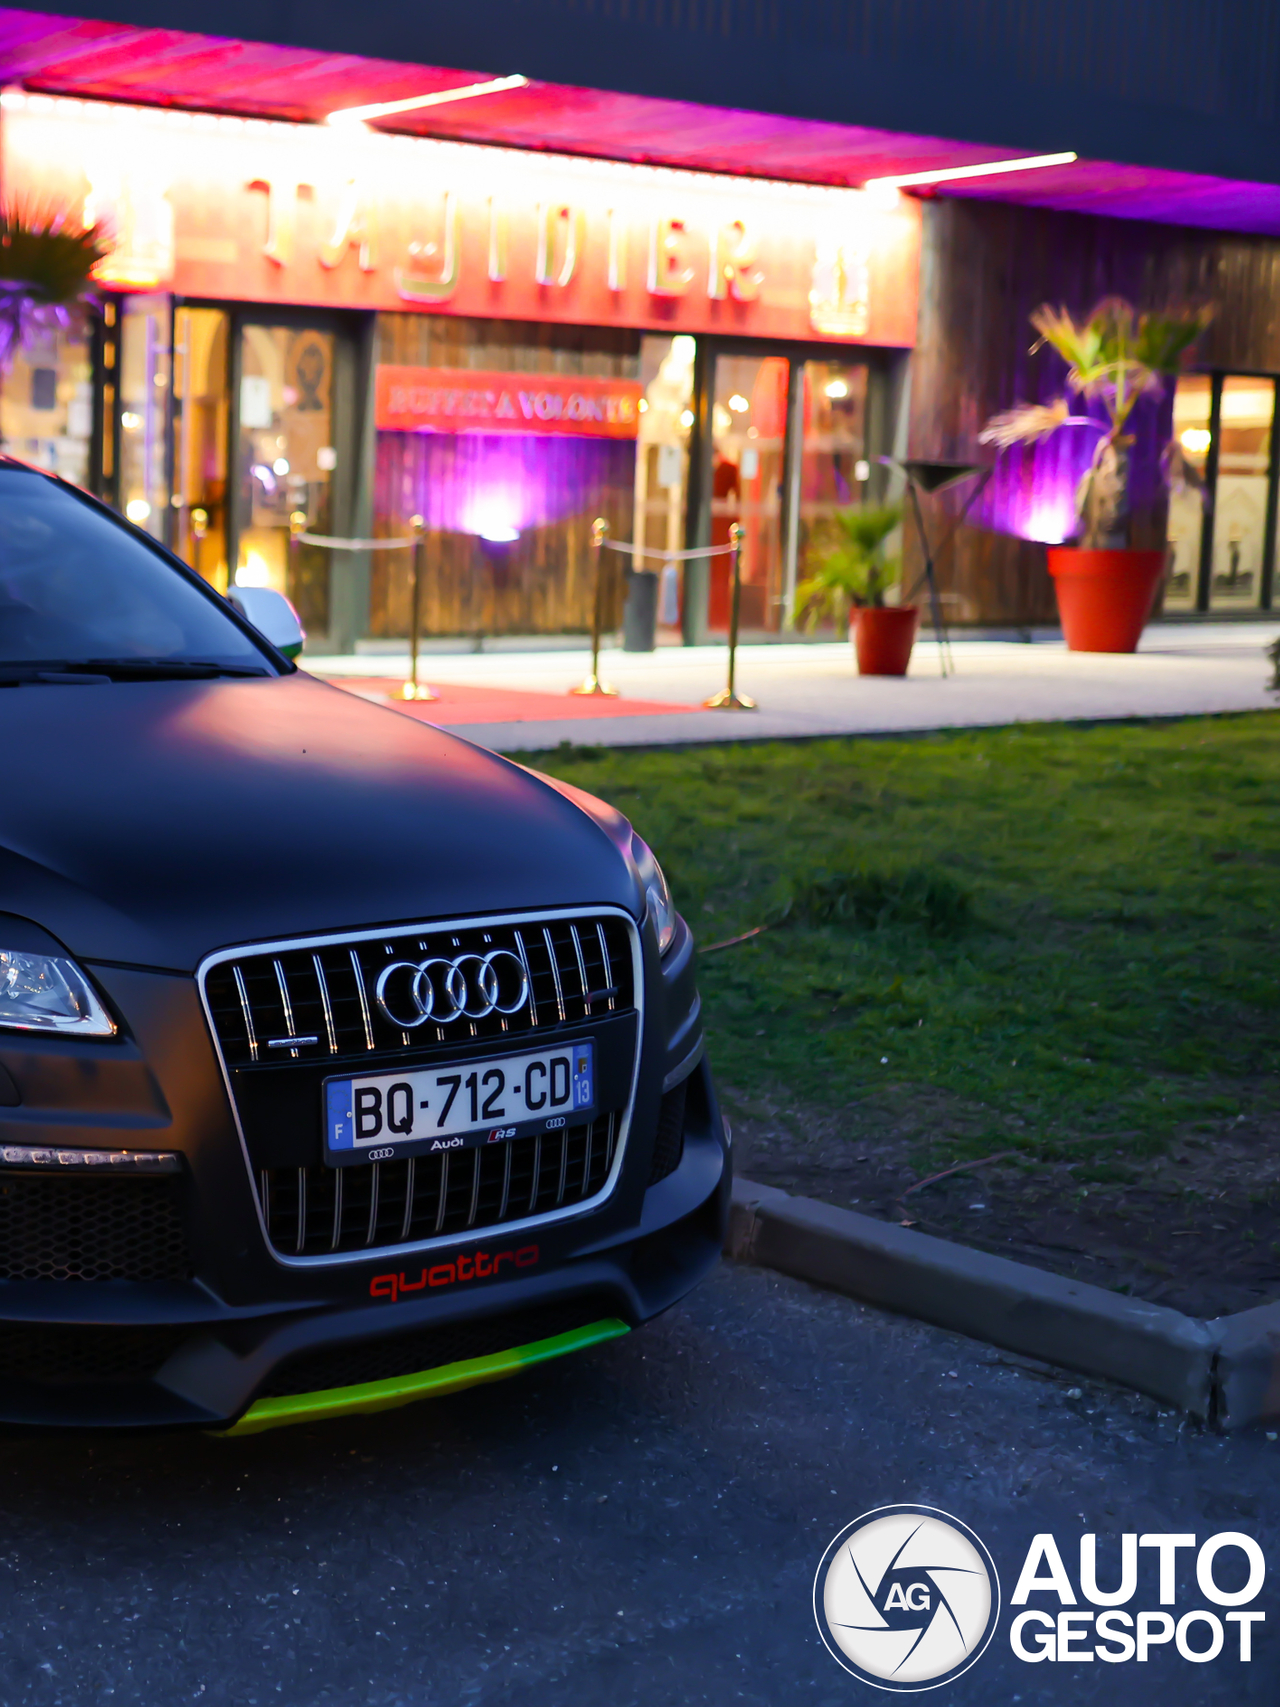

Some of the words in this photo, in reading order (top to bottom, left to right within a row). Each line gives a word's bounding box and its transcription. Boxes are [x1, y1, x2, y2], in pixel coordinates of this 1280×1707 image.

[334, 1123, 344, 1140] F
[354, 1056, 571, 1140] BQ-712-CD
[576, 1079, 590, 1104] 13
[487, 1127, 517, 1143] RS
[370, 1244, 540, 1303] quattro
